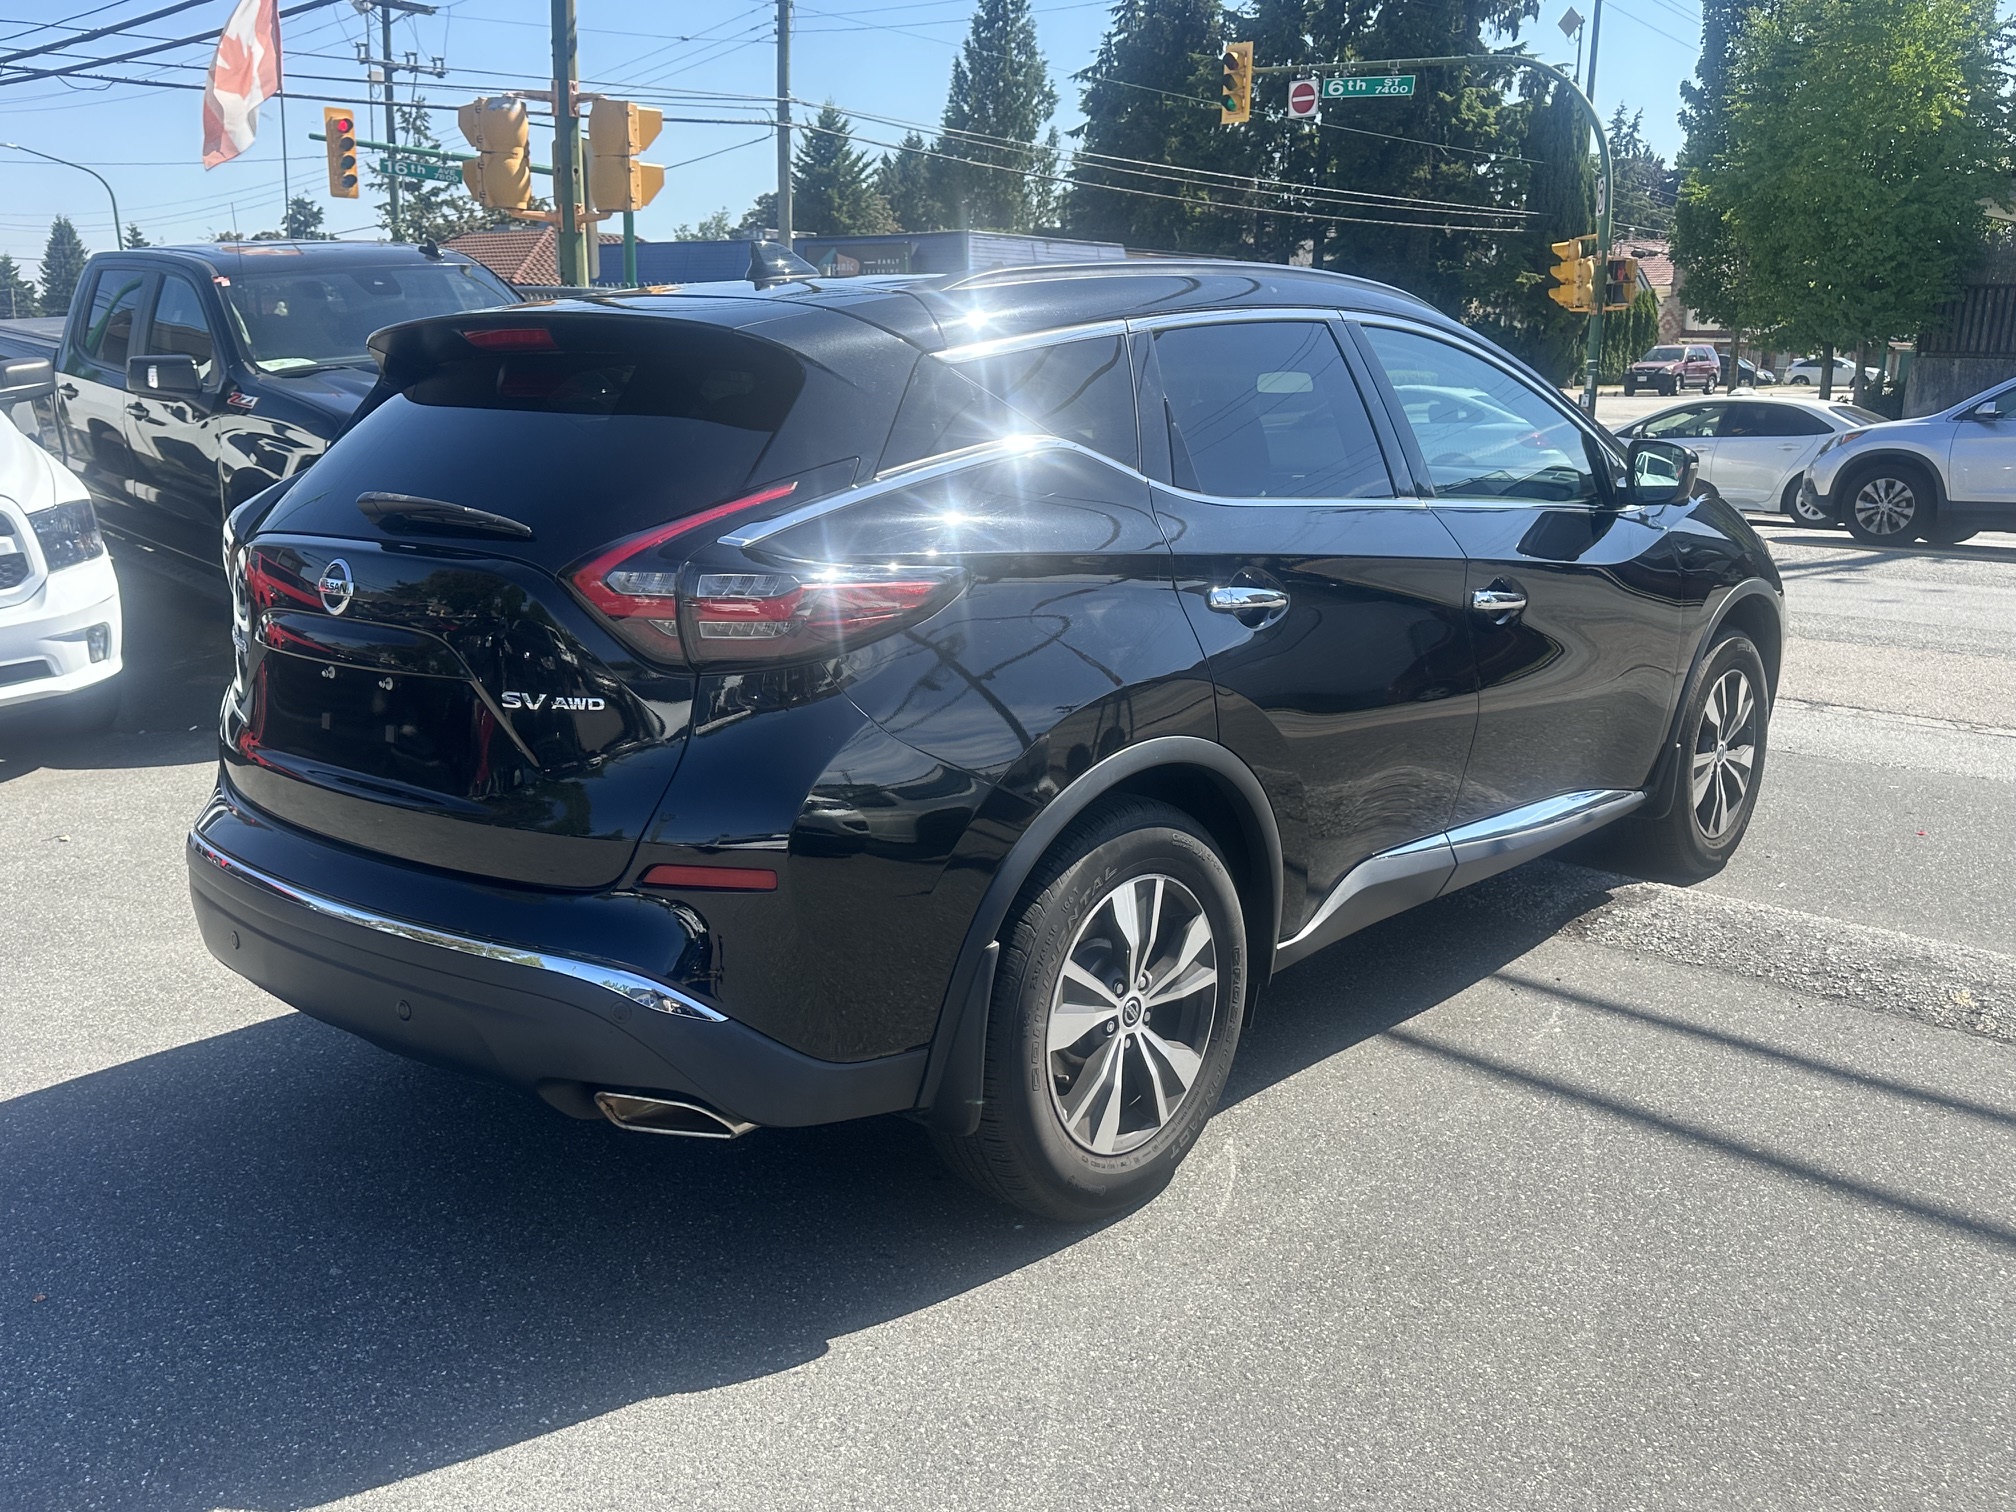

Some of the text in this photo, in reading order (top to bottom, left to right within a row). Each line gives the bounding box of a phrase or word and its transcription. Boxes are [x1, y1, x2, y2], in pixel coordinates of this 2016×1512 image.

[1328, 78, 1402, 95] 6th ST
[1375, 86, 1408, 94] 7400
[384, 161, 456, 177] 16th AVE
[433, 173, 459, 182] 7800
[501, 690, 606, 711] SV AWD
[1032, 866, 1118, 1092] CONTINENTAL
[1225, 945, 1240, 1047] CROSS
